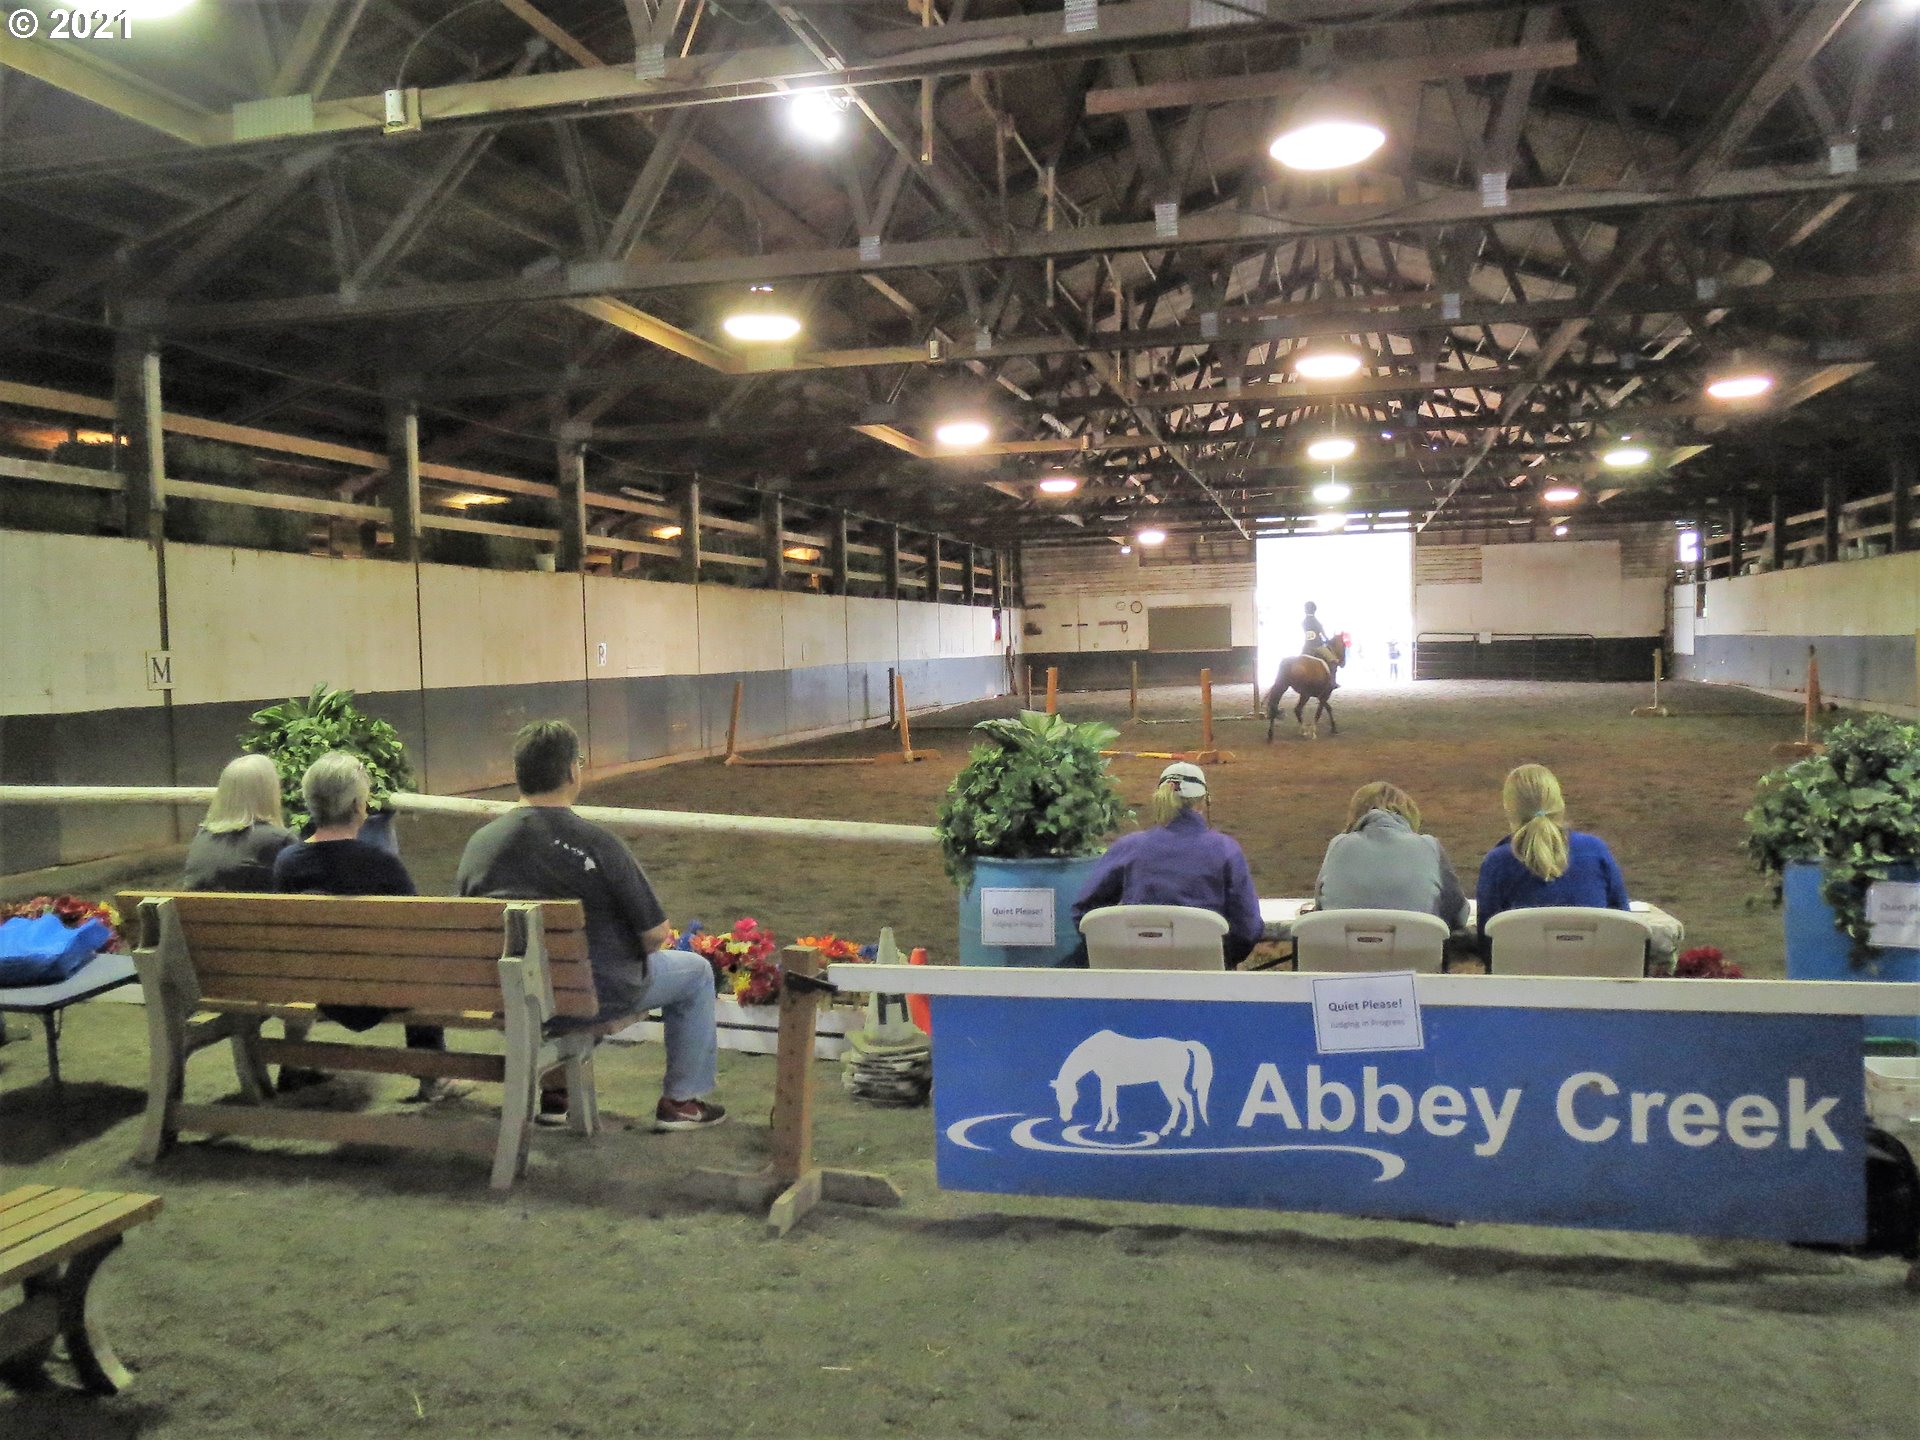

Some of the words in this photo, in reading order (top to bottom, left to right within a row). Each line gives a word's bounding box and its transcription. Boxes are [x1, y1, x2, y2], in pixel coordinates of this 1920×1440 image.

[151, 656, 172, 684] M
[1328, 1001, 1360, 1012] Quiet
[1362, 999, 1403, 1010] Please!
[1237, 1063, 1523, 1157] Abbey
[1556, 1072, 1844, 1151] Creek
